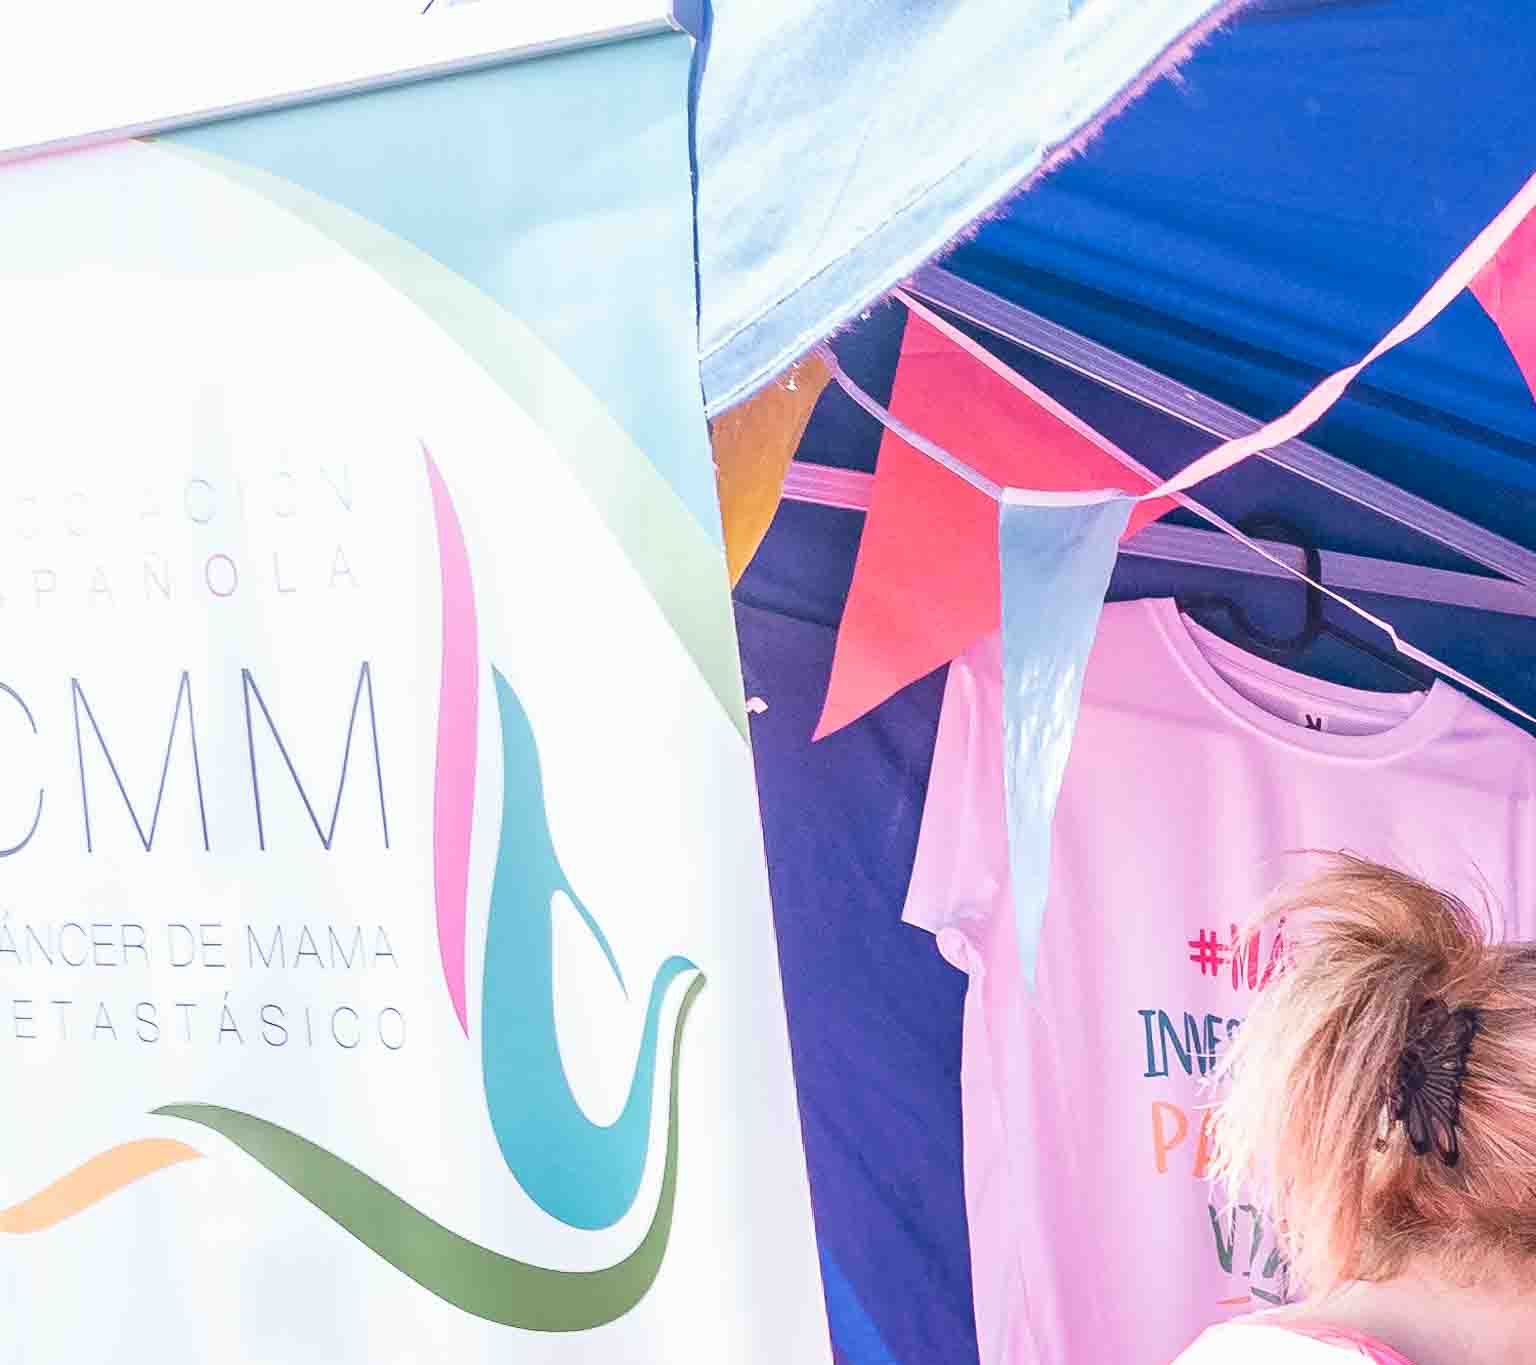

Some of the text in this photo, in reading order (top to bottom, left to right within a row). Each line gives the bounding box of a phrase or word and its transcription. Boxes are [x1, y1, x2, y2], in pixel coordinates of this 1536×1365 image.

[0, 911, 401, 971] ÁNCER DE MAMA
[13, 991, 408, 1052] ETASTÁSICO
